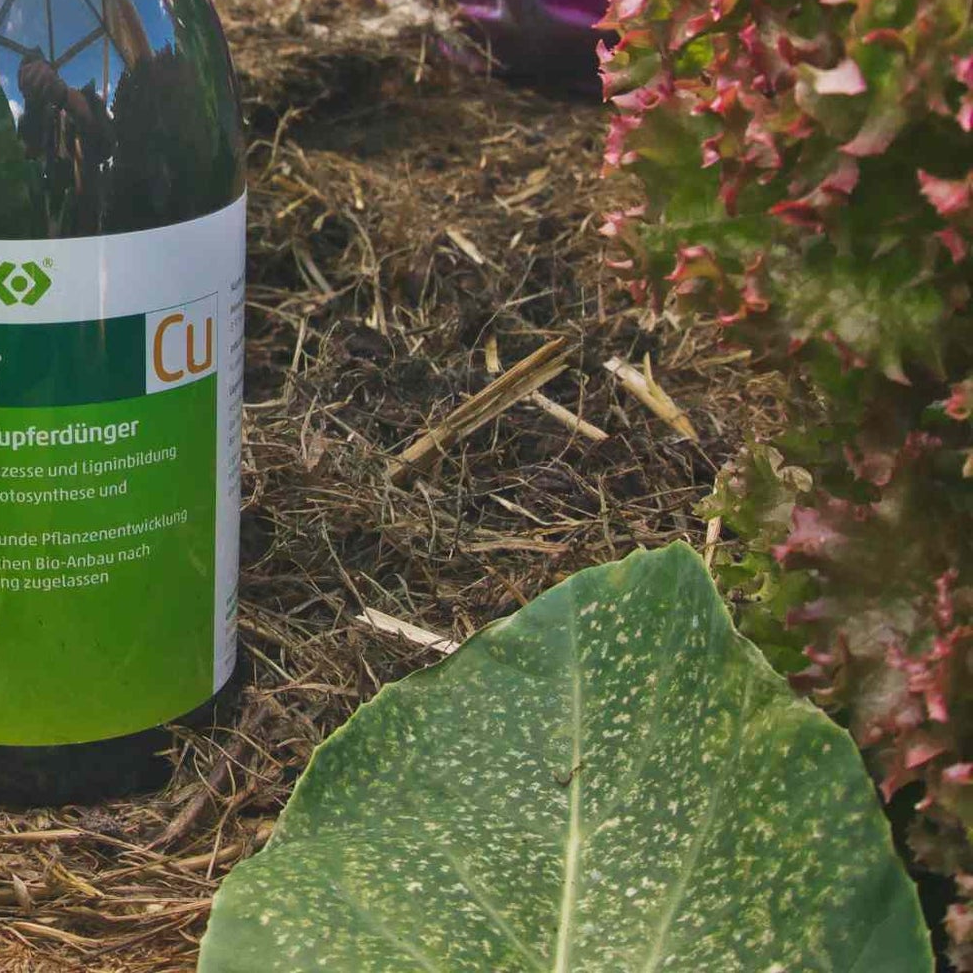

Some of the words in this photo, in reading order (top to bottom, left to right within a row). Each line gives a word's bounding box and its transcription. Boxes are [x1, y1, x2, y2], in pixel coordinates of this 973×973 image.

[153, 314, 212, 383] Cu
[48, 462, 77, 476] und
[82, 446, 176, 475] Ligninbildung
[100, 480, 127, 497] und
[42, 508, 187, 546] Pflanzenentwicklung
[36, 551, 114, 570] Bio-Anbau
[118, 544, 150, 562] nach
[24, 571, 108, 591] zugelassen
